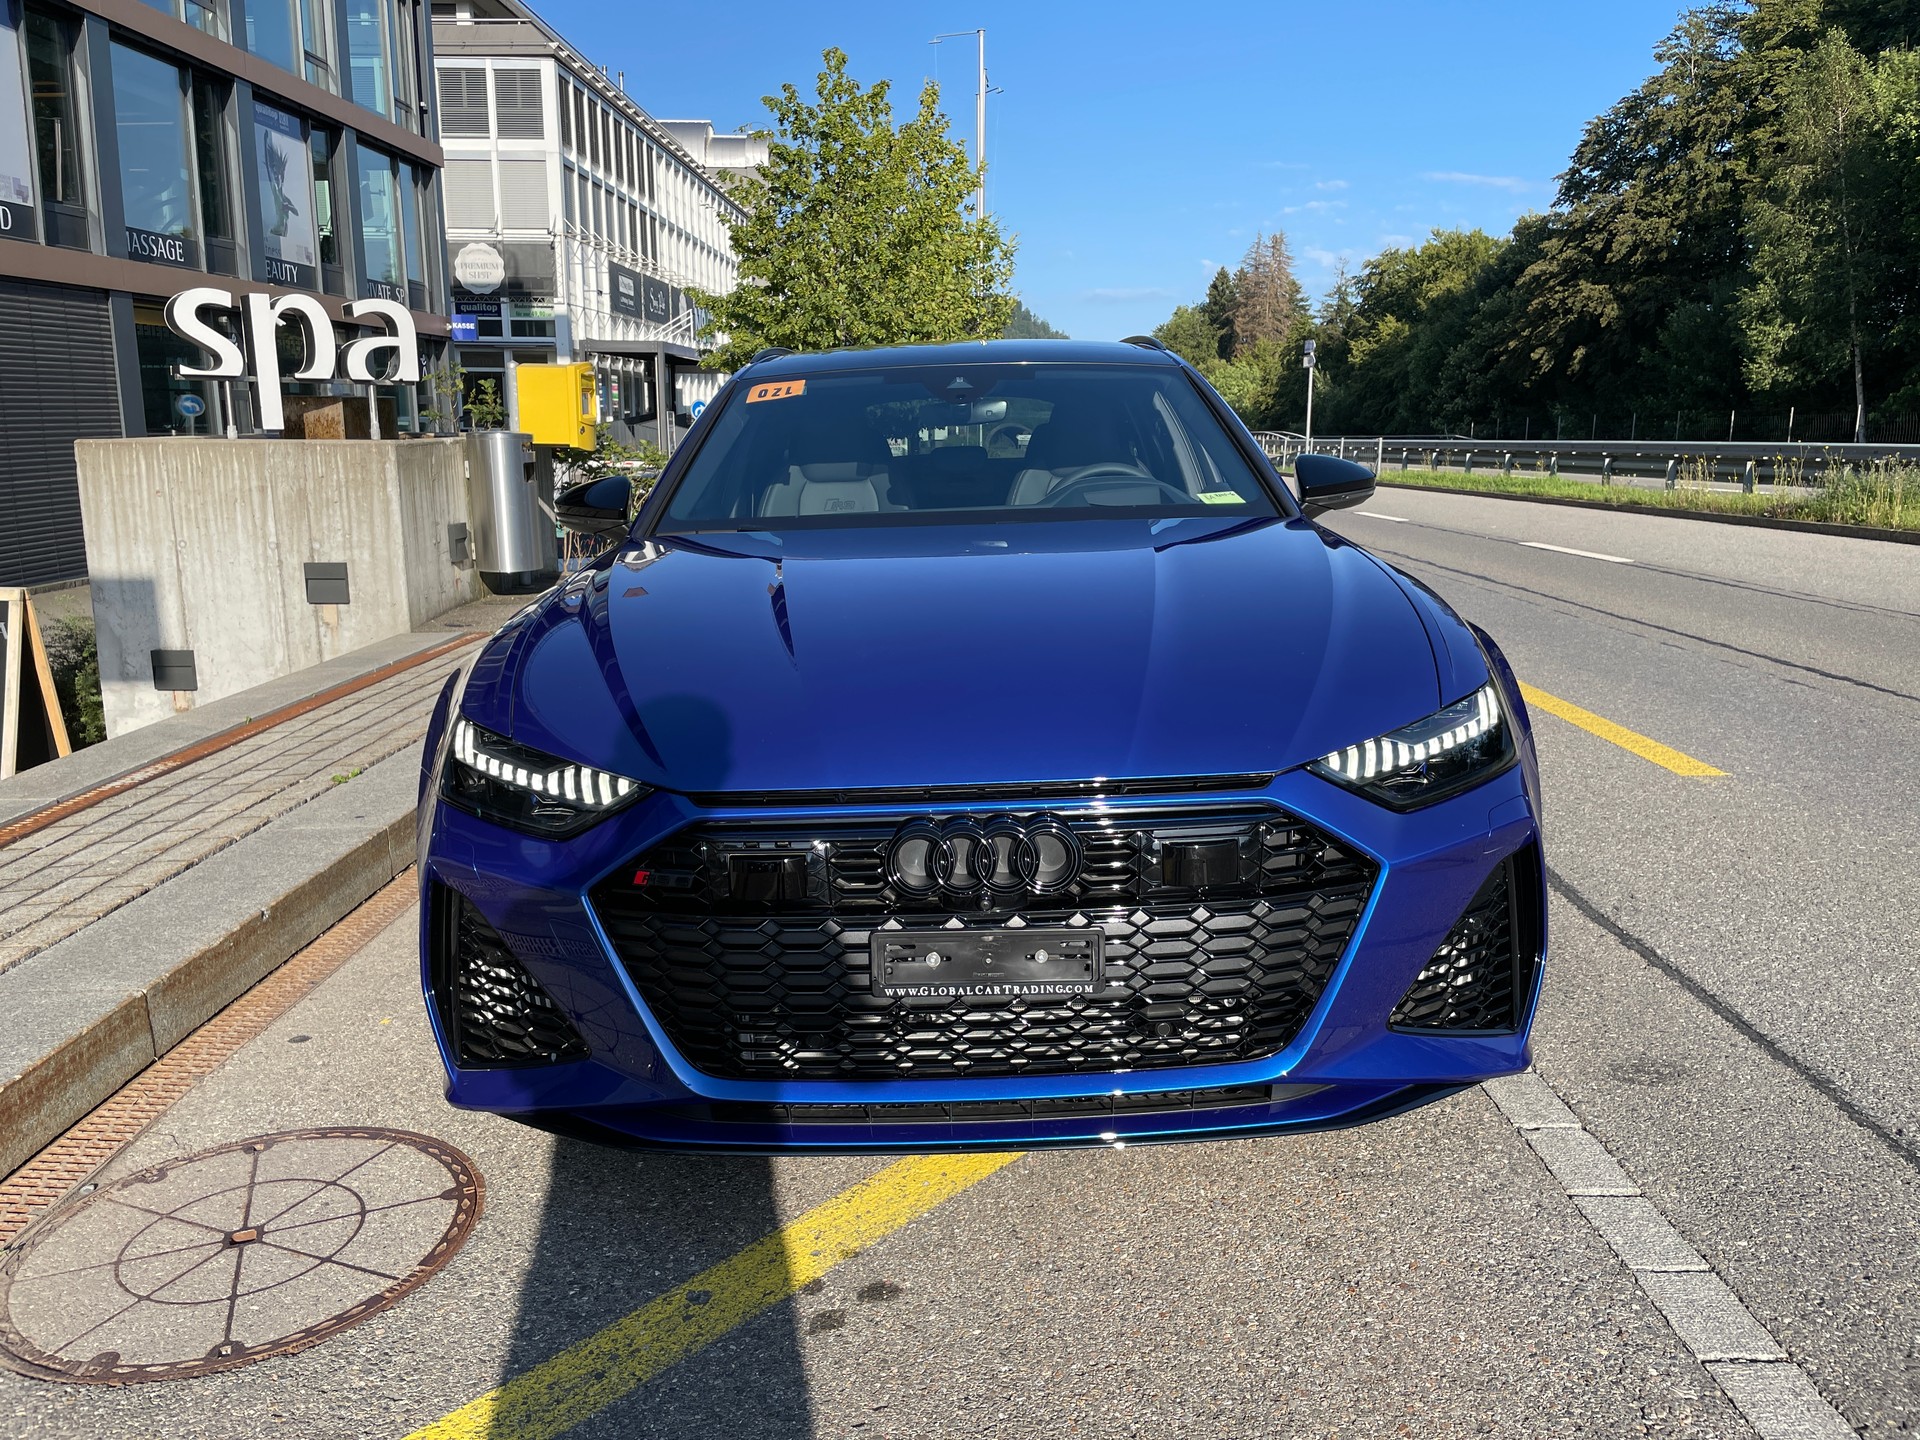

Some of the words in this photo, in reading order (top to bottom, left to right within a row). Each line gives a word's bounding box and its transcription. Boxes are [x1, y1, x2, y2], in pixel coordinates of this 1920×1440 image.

[460, 262, 499, 270] PREMIUM
[460, 303, 498, 312] qualitop
[164, 287, 420, 431] spa
